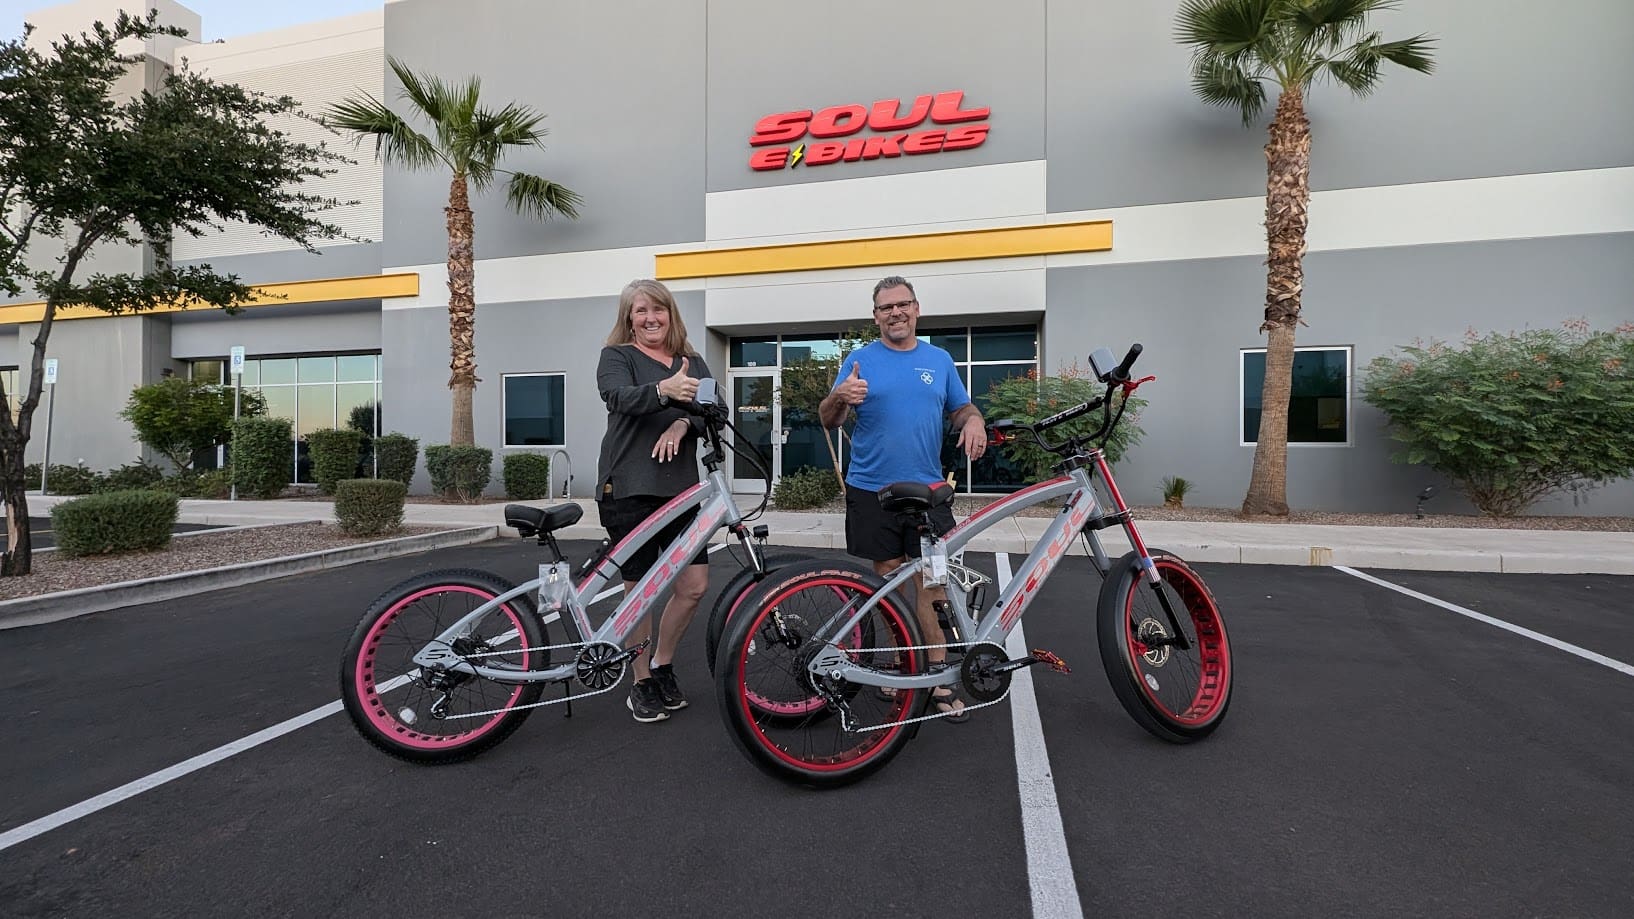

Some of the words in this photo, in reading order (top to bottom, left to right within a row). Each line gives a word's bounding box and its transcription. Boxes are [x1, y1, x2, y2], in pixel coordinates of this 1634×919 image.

[750, 91, 990, 146] SOUL
[614, 504, 728, 634] SOUL
[1001, 501, 1094, 627] SOUL
